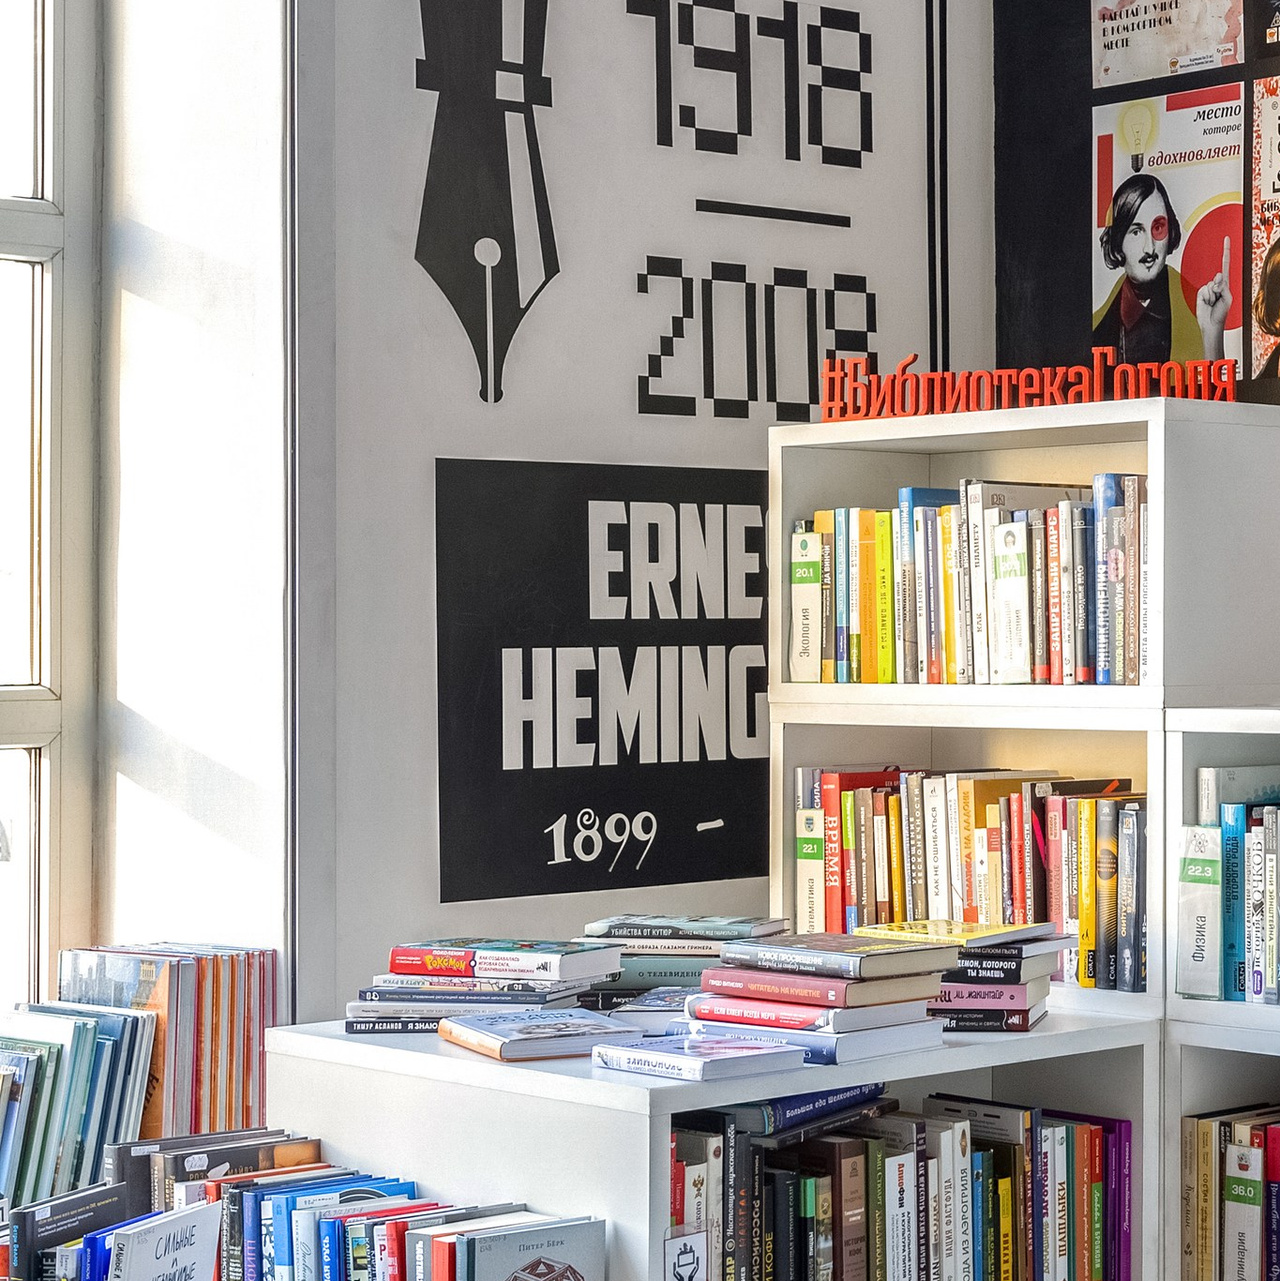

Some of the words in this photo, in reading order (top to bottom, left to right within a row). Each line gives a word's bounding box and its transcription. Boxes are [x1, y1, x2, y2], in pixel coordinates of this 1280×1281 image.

[1194, 104, 1242, 123] место
[1202, 122, 1242, 136] которое
[1148, 143, 1241, 167] вдохновляет
[637, 256, 878, 422] 2008
[821, 346, 1238, 422] #БиблиотекаГоголя
[795, 567, 814, 578] 20.1
[800, 608, 811, 658] Экология
[501, 645, 768, 769] HEMING
[545, 807, 658, 874] 1899
[803, 844, 817, 854] 22.1
[827, 816, 840, 888] ВРЕМЯ
[1187, 864, 1213, 877] 22.3
[1193, 915, 1207, 963] Физика
[781, 953, 823, 965] ПРОСВЕЩЕНИЕ
[985, 960, 1016, 971] КОТОРОГО
[748, 982, 780, 994] ЧИТАТЕЛЬ
[792, 987, 821, 998] КУШЕТКЕ
[1231, 1184, 1254, 1198] 36.0
[155, 1224, 197, 1261] СИЛЬНЫЕ
